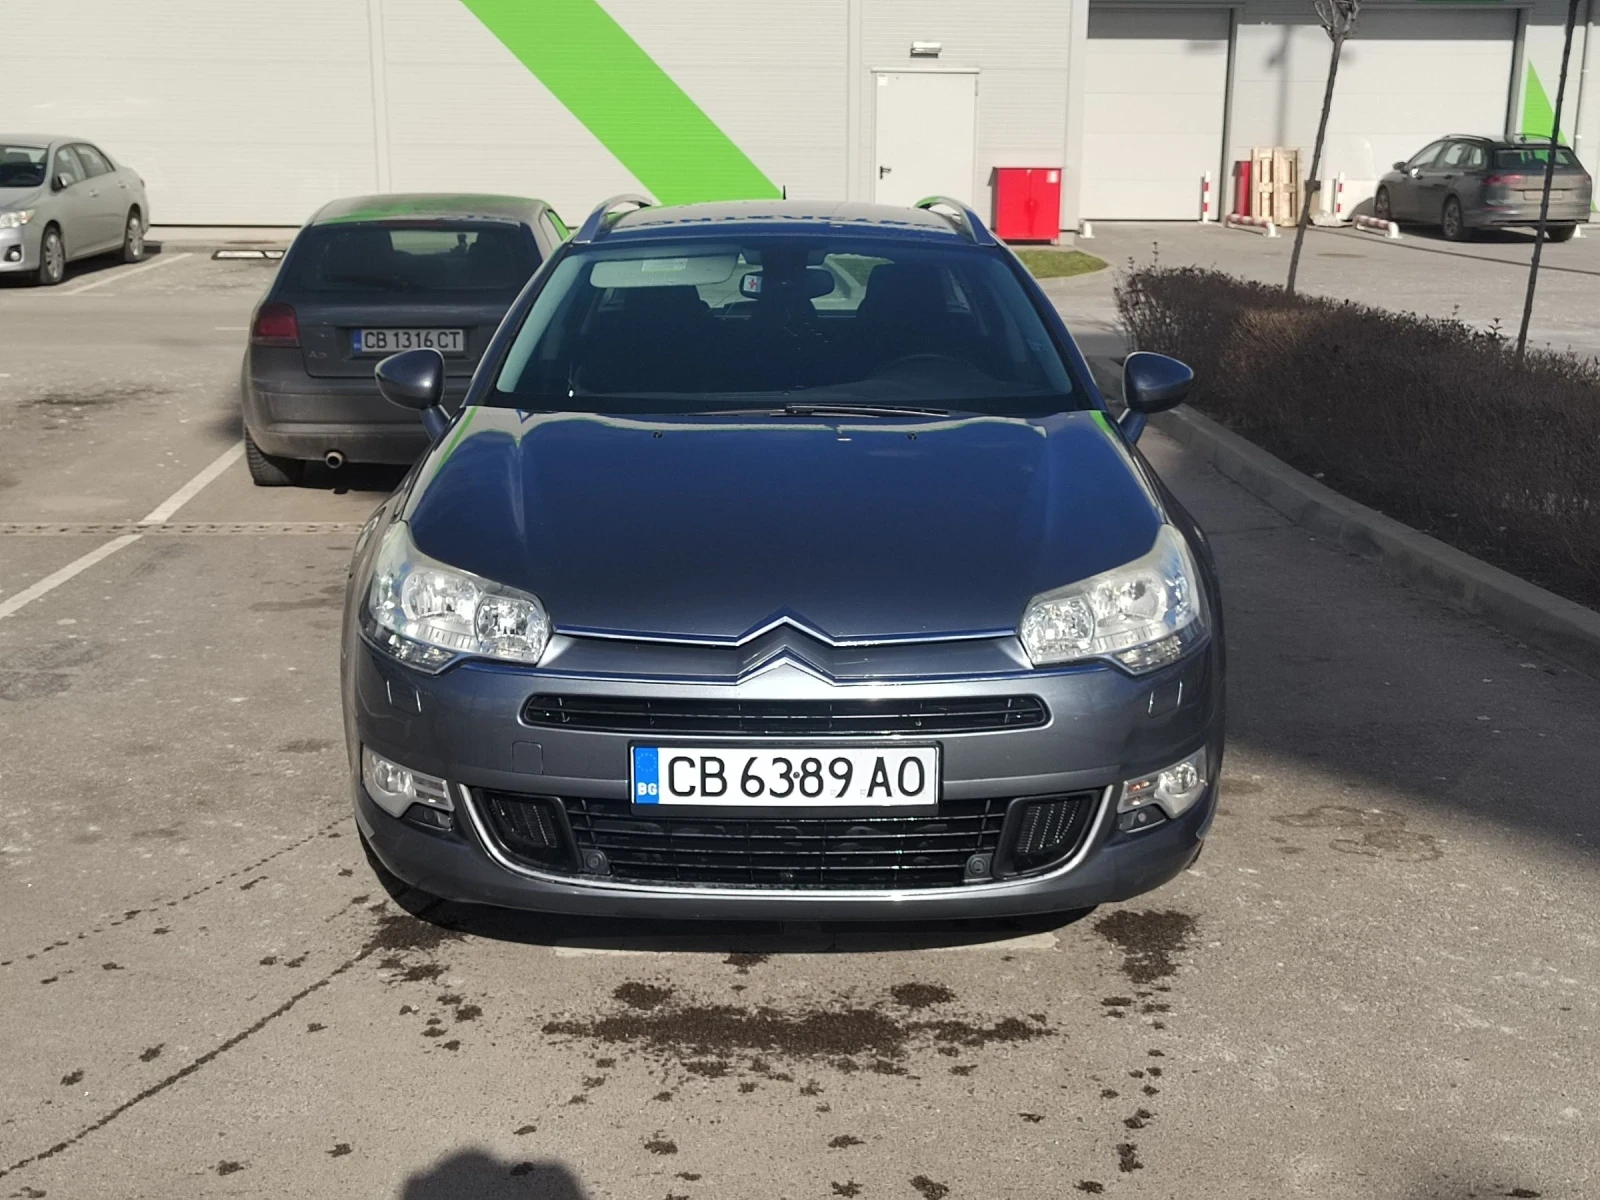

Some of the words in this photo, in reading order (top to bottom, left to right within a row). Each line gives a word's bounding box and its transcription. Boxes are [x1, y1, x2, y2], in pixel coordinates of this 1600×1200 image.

[364, 331, 387, 349] CB
[393, 331, 434, 349] 1316
[437, 331, 460, 349] CT
[668, 755, 728, 797] CB
[740, 756, 854, 798] 6389
[866, 756, 925, 797] AO
[637, 782, 658, 796] BG
